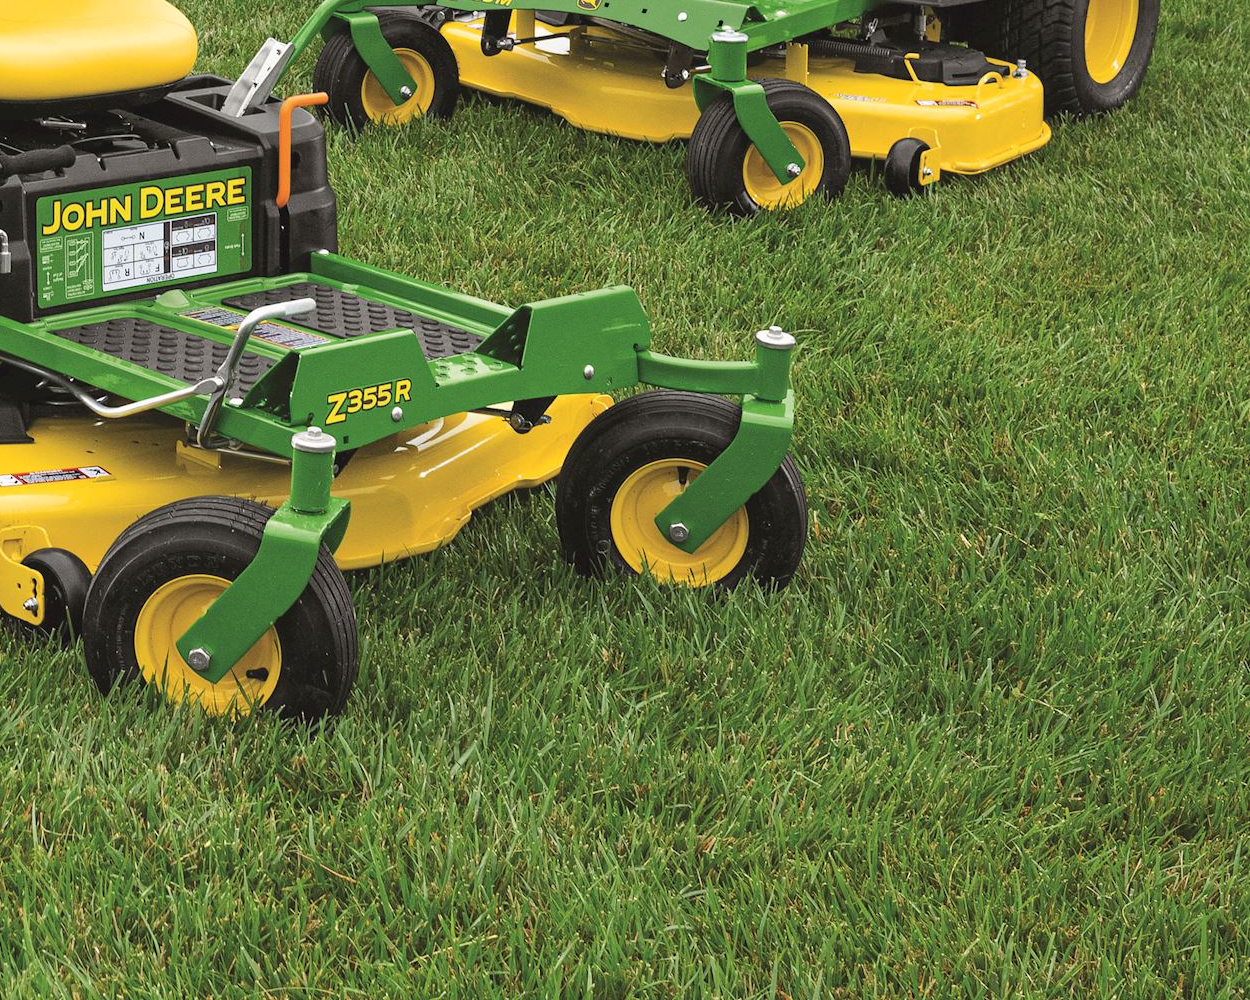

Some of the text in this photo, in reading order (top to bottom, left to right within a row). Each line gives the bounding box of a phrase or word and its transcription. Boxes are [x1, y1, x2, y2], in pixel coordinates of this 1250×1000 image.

[41, 194, 132, 235] JOHN
[139, 177, 246, 220] DEERE
[139, 231, 145, 240] N
[124, 263, 161, 277] F R
[146, 273, 175, 283] OPERATION
[325, 378, 412, 426] Z355R
